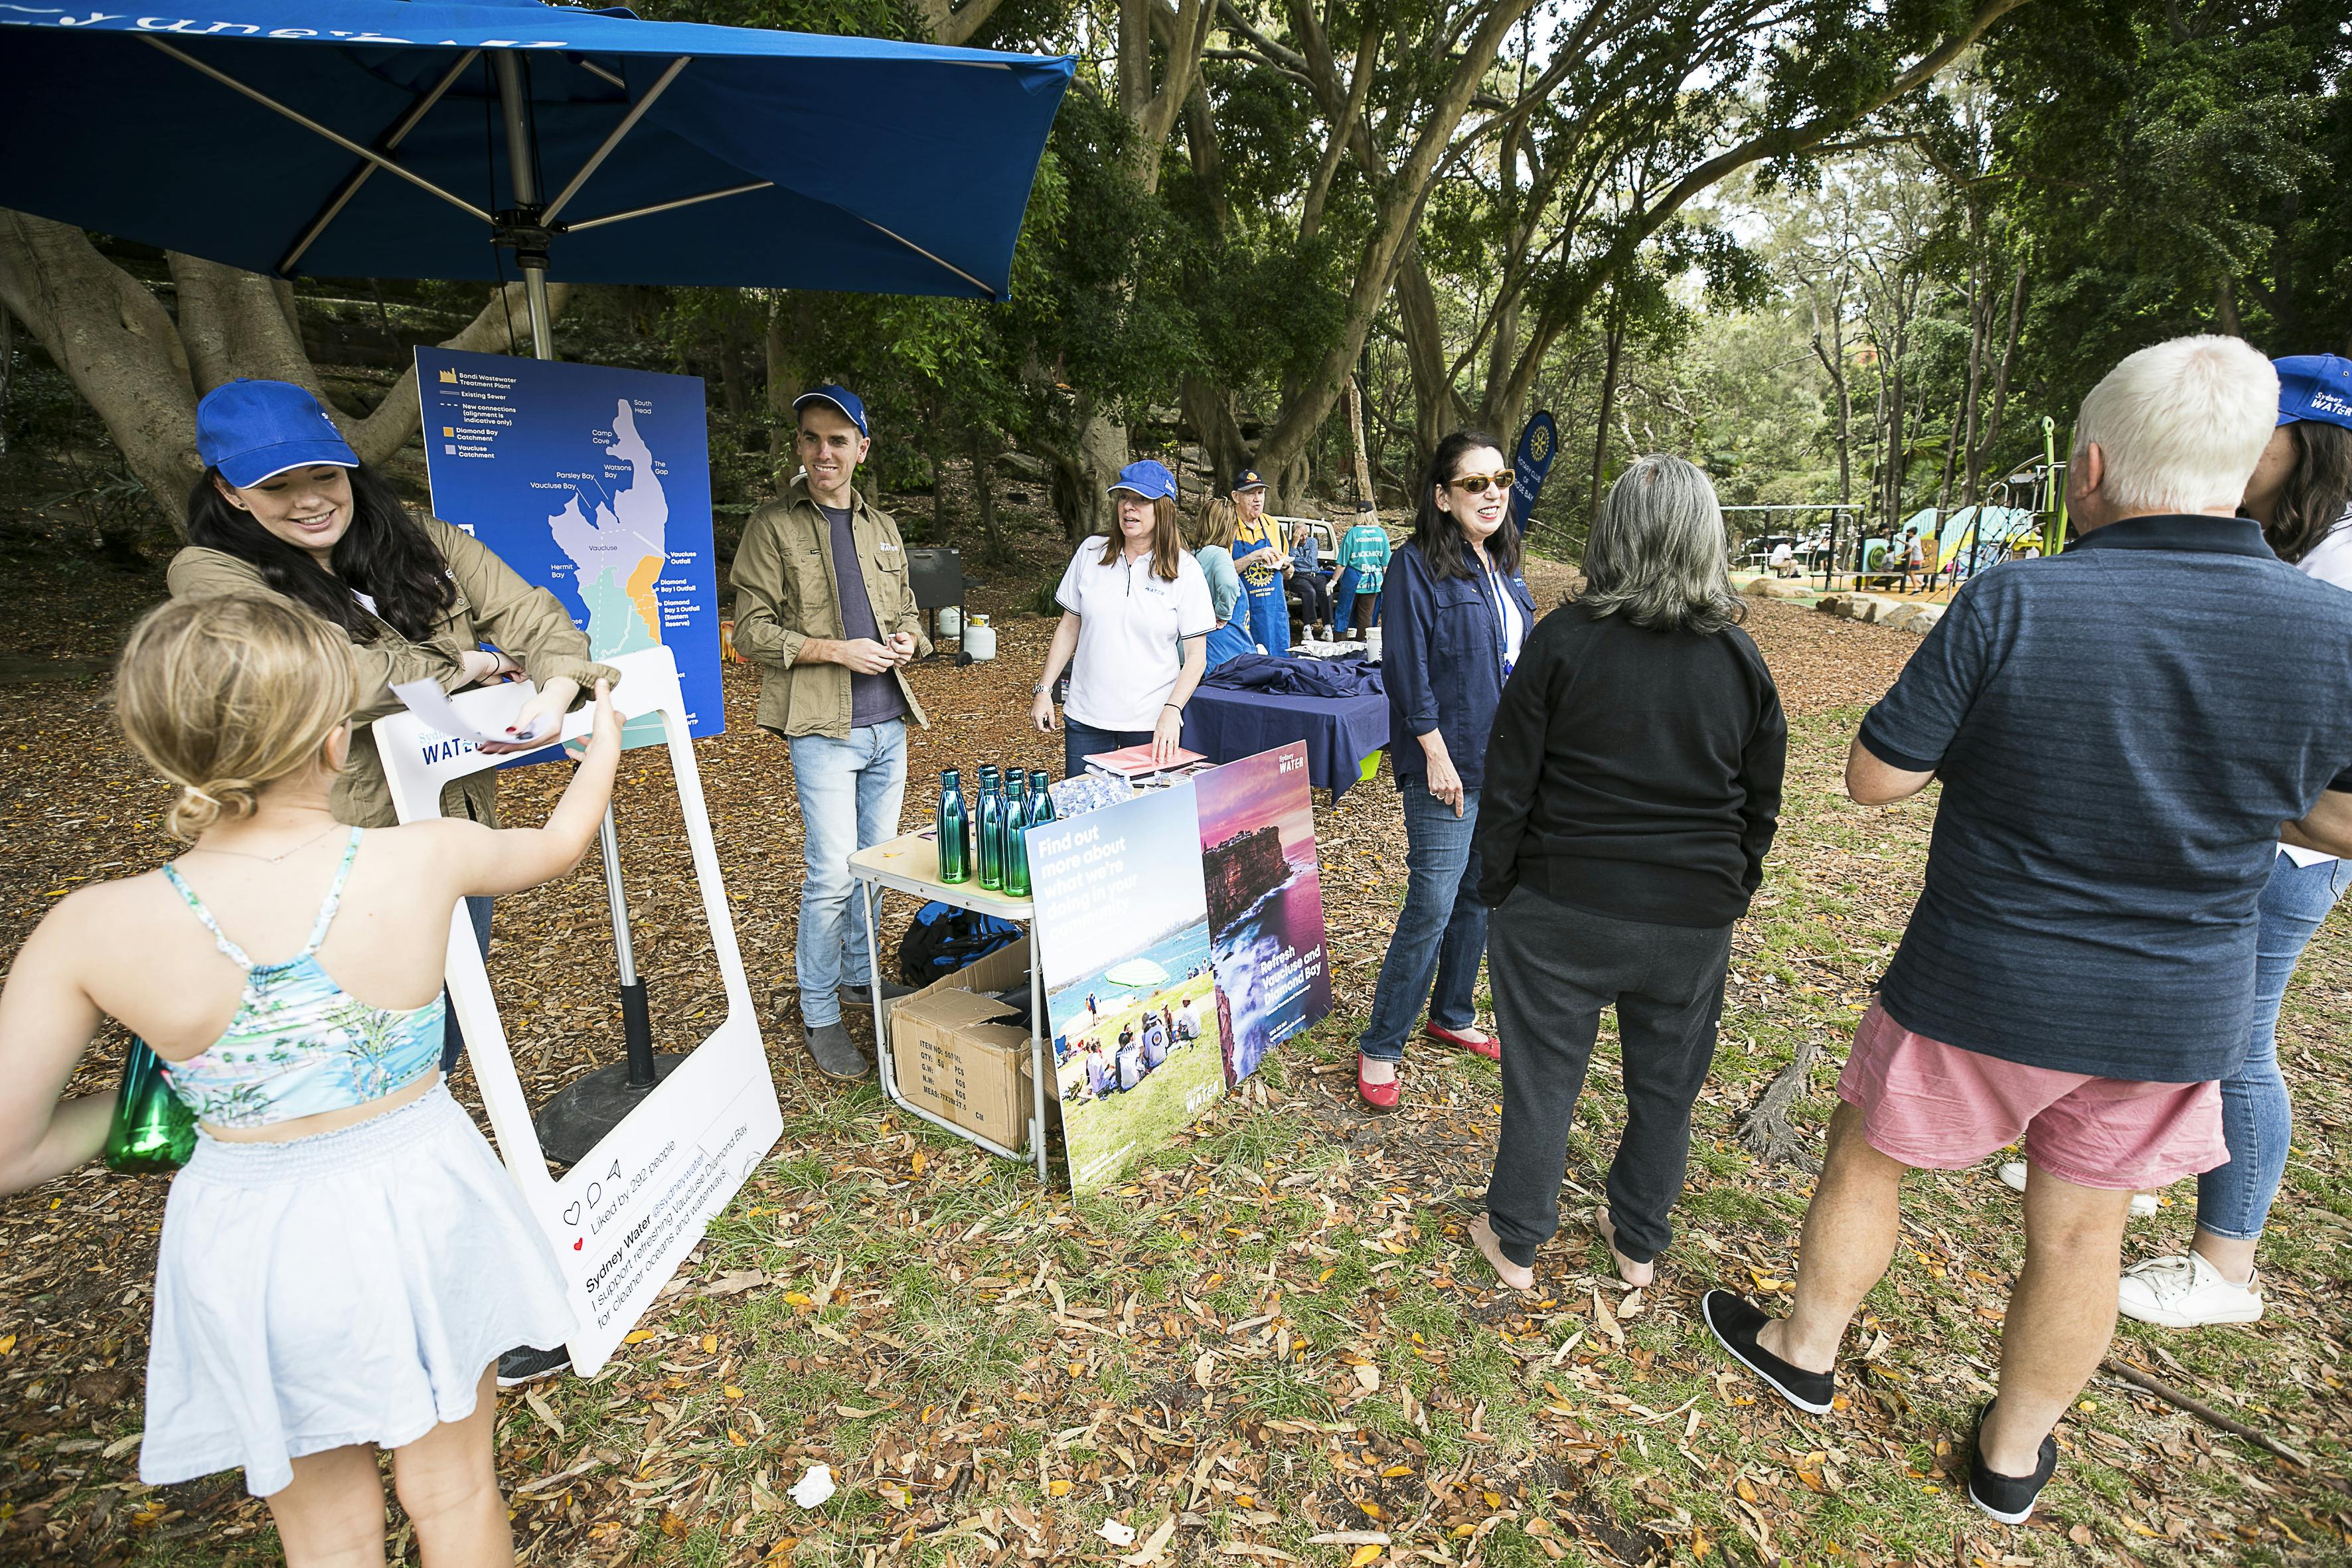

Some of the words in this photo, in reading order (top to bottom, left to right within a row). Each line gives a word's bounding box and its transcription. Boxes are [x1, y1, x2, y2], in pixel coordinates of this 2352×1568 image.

[2311, 399, 2352, 417] WATER
[2315, 392, 2343, 403] Sydney
[1518, 456, 1531, 473] ROTARY
[1531, 471, 1541, 483] CLUB
[1514, 478, 1525, 494] ROSE
[1524, 489, 1534, 502] BAY
[422, 738, 483, 765] WATE
[1280, 757, 1304, 774] WATER
[1038, 832, 1072, 858] Find
[1074, 824, 1099, 846] out
[1041, 854, 1081, 880] more
[1083, 836, 1126, 864] about
[1044, 872, 1084, 900] what
[1085, 860, 1124, 884] we're
[1046, 893, 1090, 920] doing
[1092, 885, 1105, 903] in
[1108, 874, 1138, 902] your
[1050, 897, 1130, 940] community
[1260, 945, 1295, 975] Refresh
[1262, 958, 1302, 990] Vaucluse
[1304, 944, 1321, 965] and
[1264, 969, 1304, 1006] Diamond
[1305, 961, 1321, 980] Bay
[920, 1040, 933, 1051] ITEM
[933, 1046, 943, 1055] NO:
[921, 1052, 933, 1062] QTY:
[937, 1059, 945, 1068] 50
[955, 1066, 965, 1076] PCS
[921, 1063, 933, 1074] G.W:
[955, 1078, 966, 1089] KGS
[923, 1075, 934, 1085] N.W:
[955, 1089, 966, 1100] KGS
[923, 1086, 939, 1099] MEAS:
[975, 1112, 984, 1121] CM
[1186, 1080, 1219, 1113] WATER
[591, 1201, 617, 1235] Liked
[617, 1189, 629, 1206] by
[631, 1168, 648, 1193] 292
[649, 1141, 675, 1176] people
[586, 1247, 623, 1293] Sydney
[624, 1214, 651, 1249] Water
[653, 1153, 704, 1217] @sydneywater
[591, 1300, 597, 1312] I
[598, 1259, 632, 1305] support
[634, 1214, 673, 1263] refreshing
[672, 1174, 705, 1214] Vaucluse
[705, 1137, 735, 1176] Diamond
[735, 1123, 747, 1141] Bay
[598, 1309, 610, 1329] for
[613, 1268, 643, 1311] cleaner
[646, 1233, 674, 1271] oceans
[675, 1212, 690, 1235] and
[690, 1169, 726, 1215] waterways
